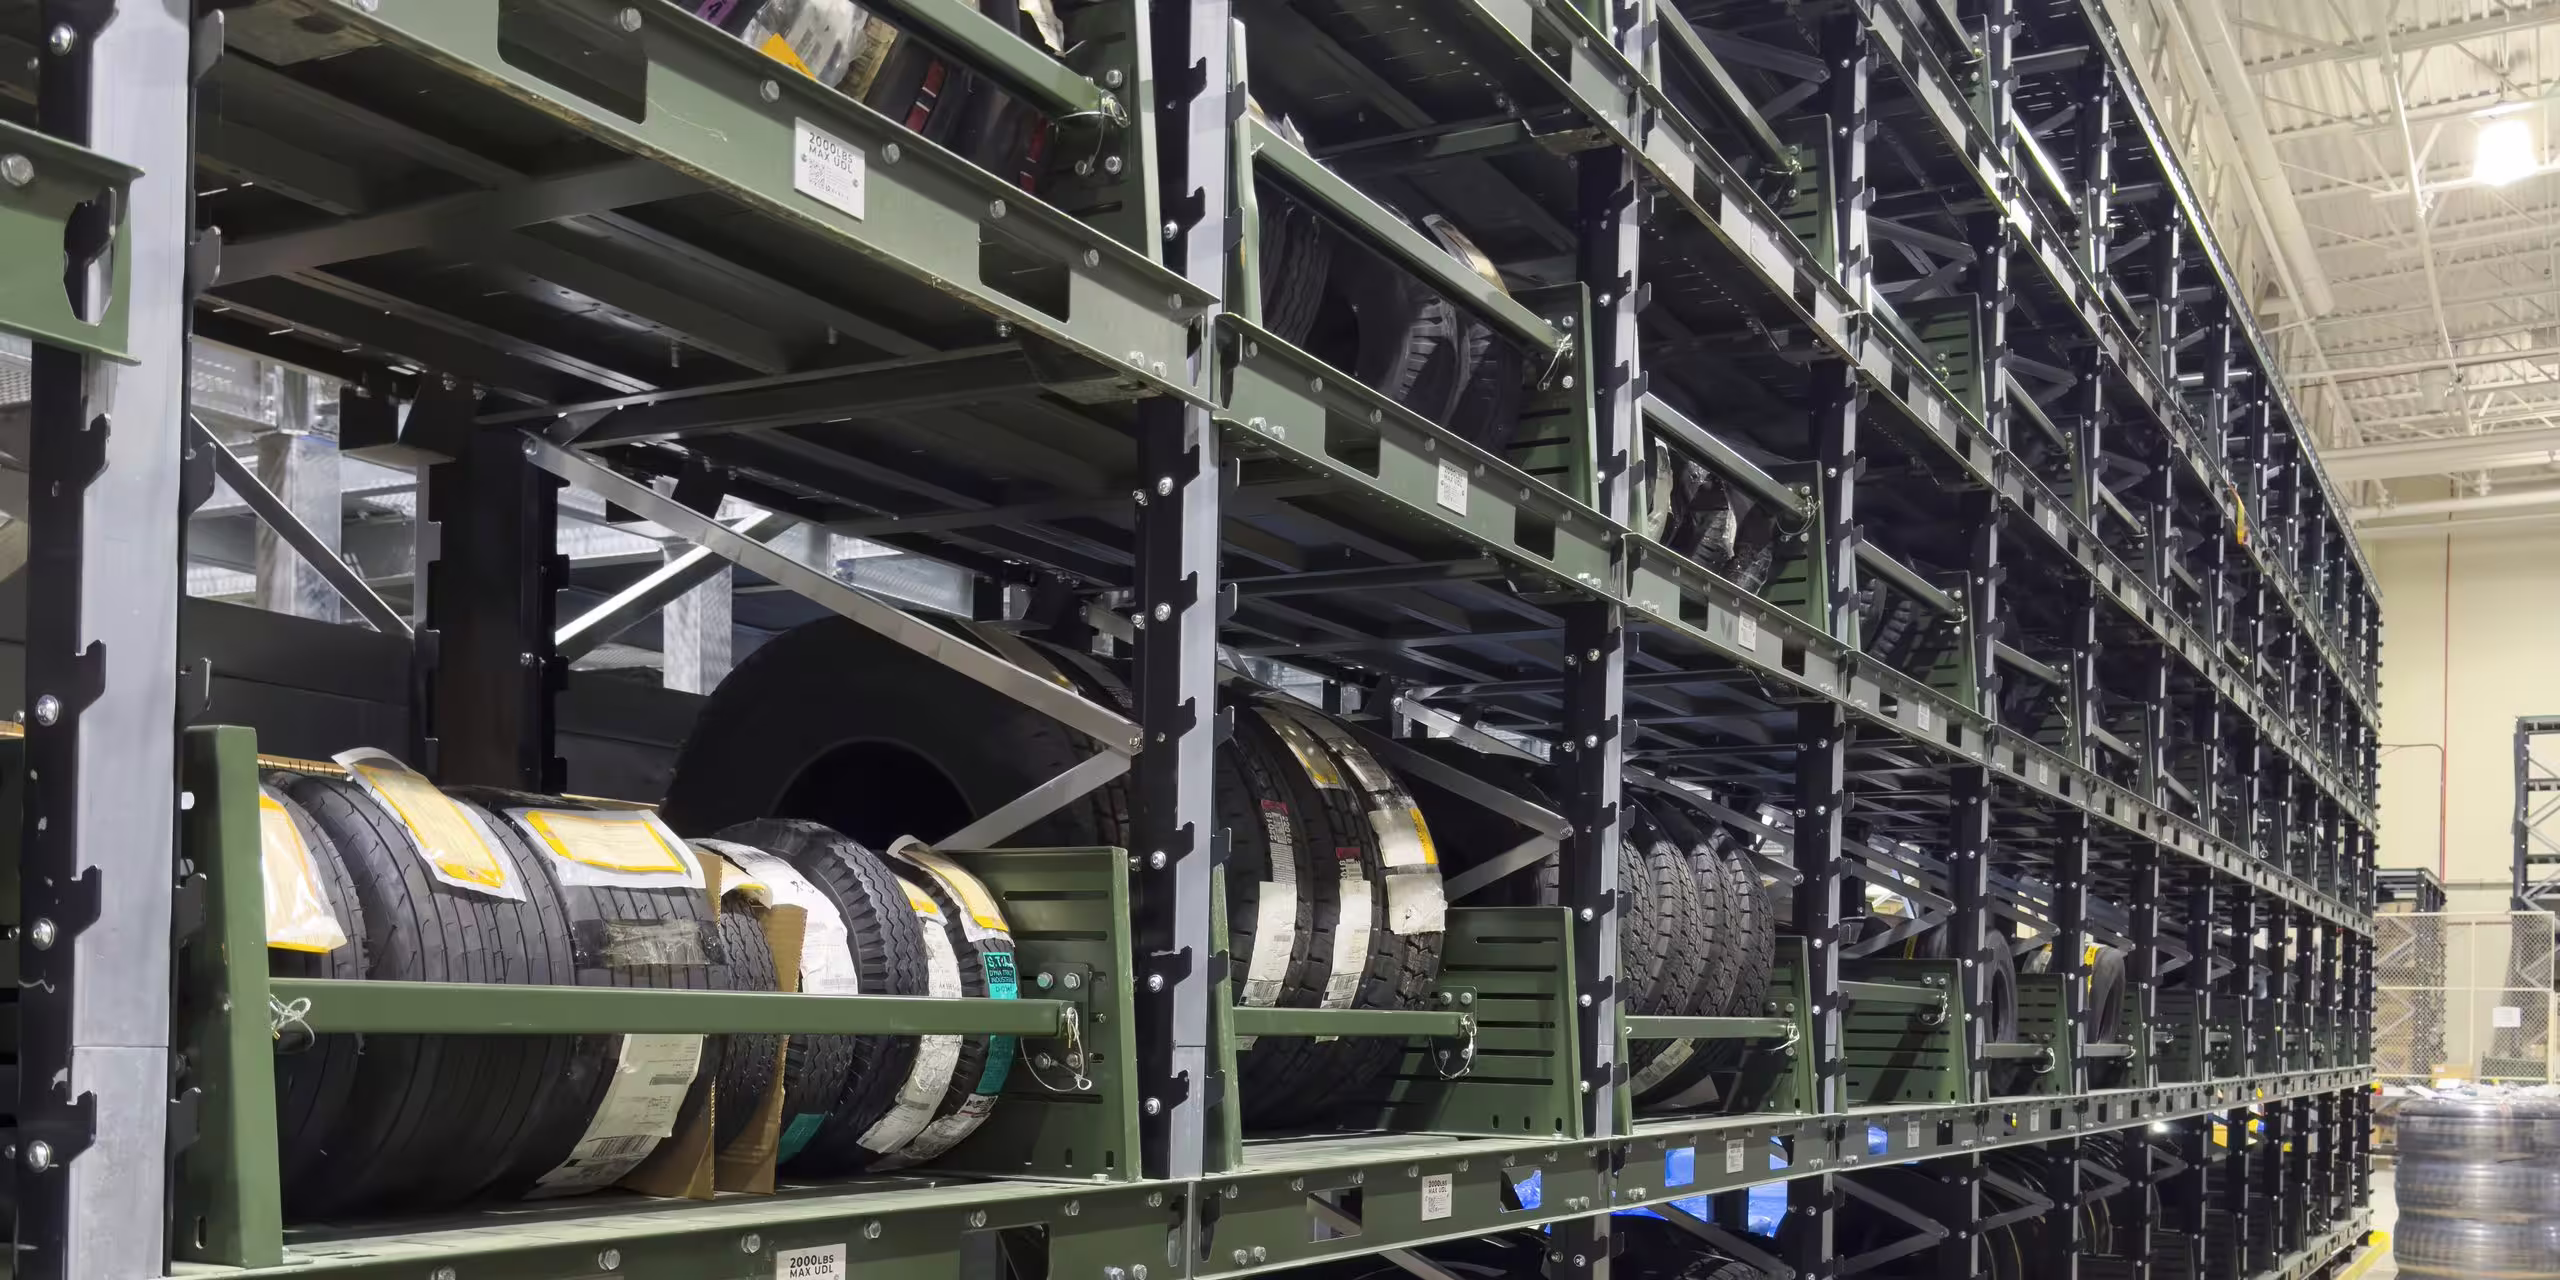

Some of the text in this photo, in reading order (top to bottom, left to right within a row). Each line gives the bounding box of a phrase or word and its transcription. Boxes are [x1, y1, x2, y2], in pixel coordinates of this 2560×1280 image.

[809, 132, 853, 164] 2000LBS
[809, 144, 853, 174] MAX UDL
[790, 1254, 834, 1269] 2000LBS
[790, 1264, 833, 1279] MAX UDL
